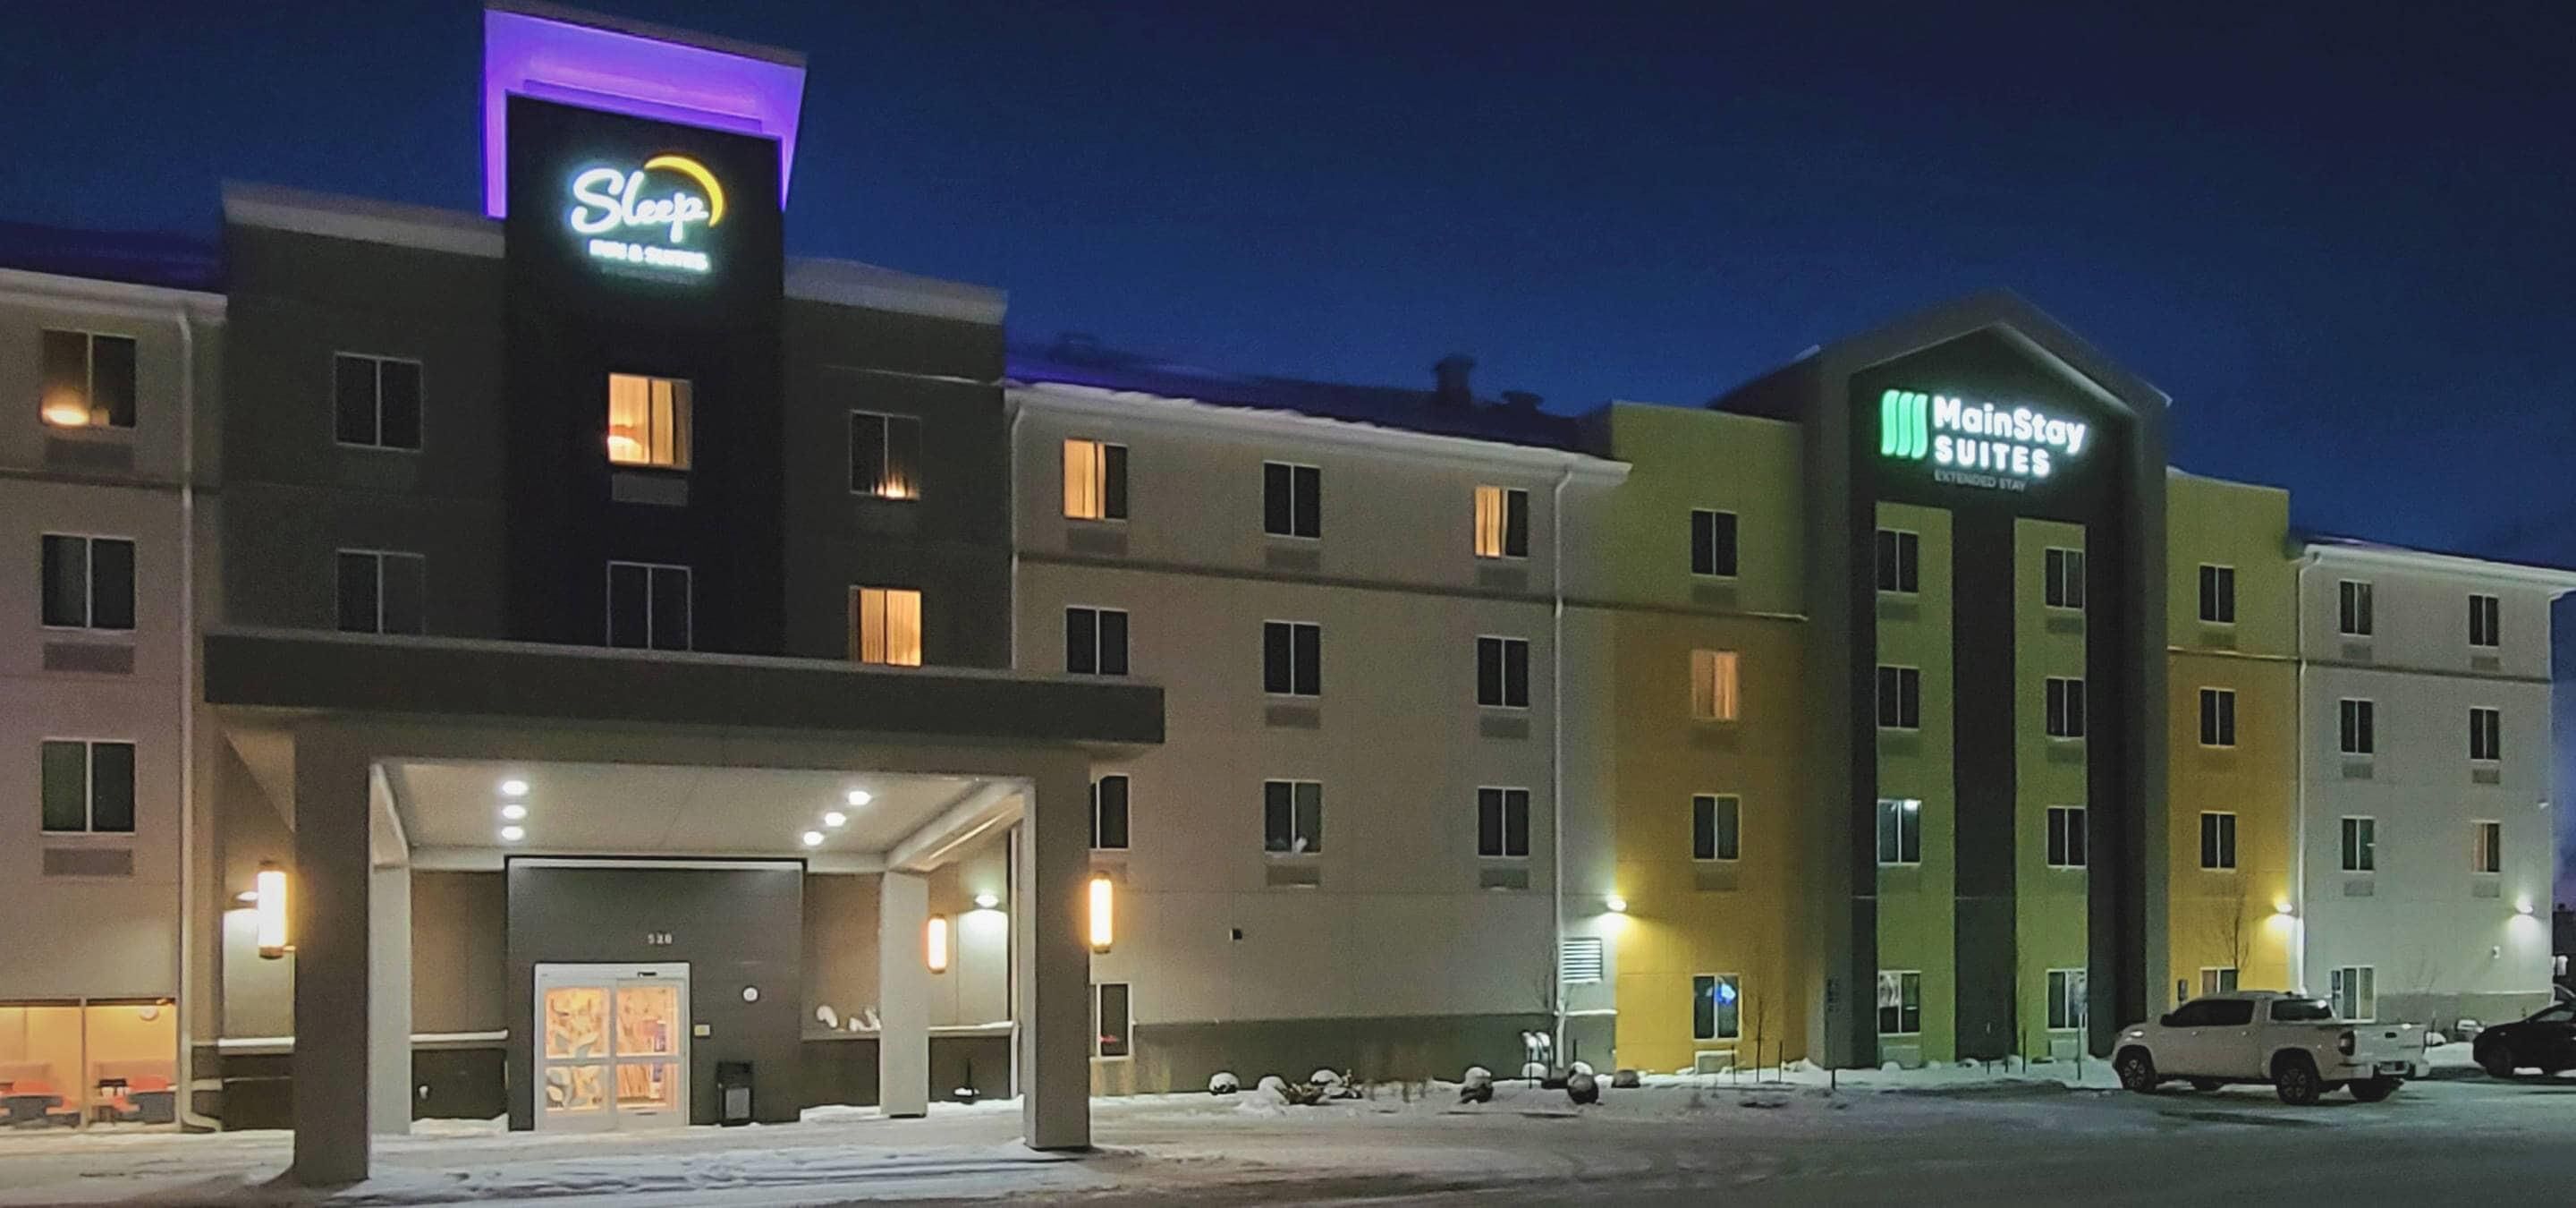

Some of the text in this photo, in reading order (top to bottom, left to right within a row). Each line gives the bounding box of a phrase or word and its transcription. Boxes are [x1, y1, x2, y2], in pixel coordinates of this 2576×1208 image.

[571, 167, 709, 243] Sleep
[1932, 395, 2087, 455] MainStay
[1934, 434, 2052, 479] SUITES
[1934, 469, 2028, 492] EXTENDED STAY
